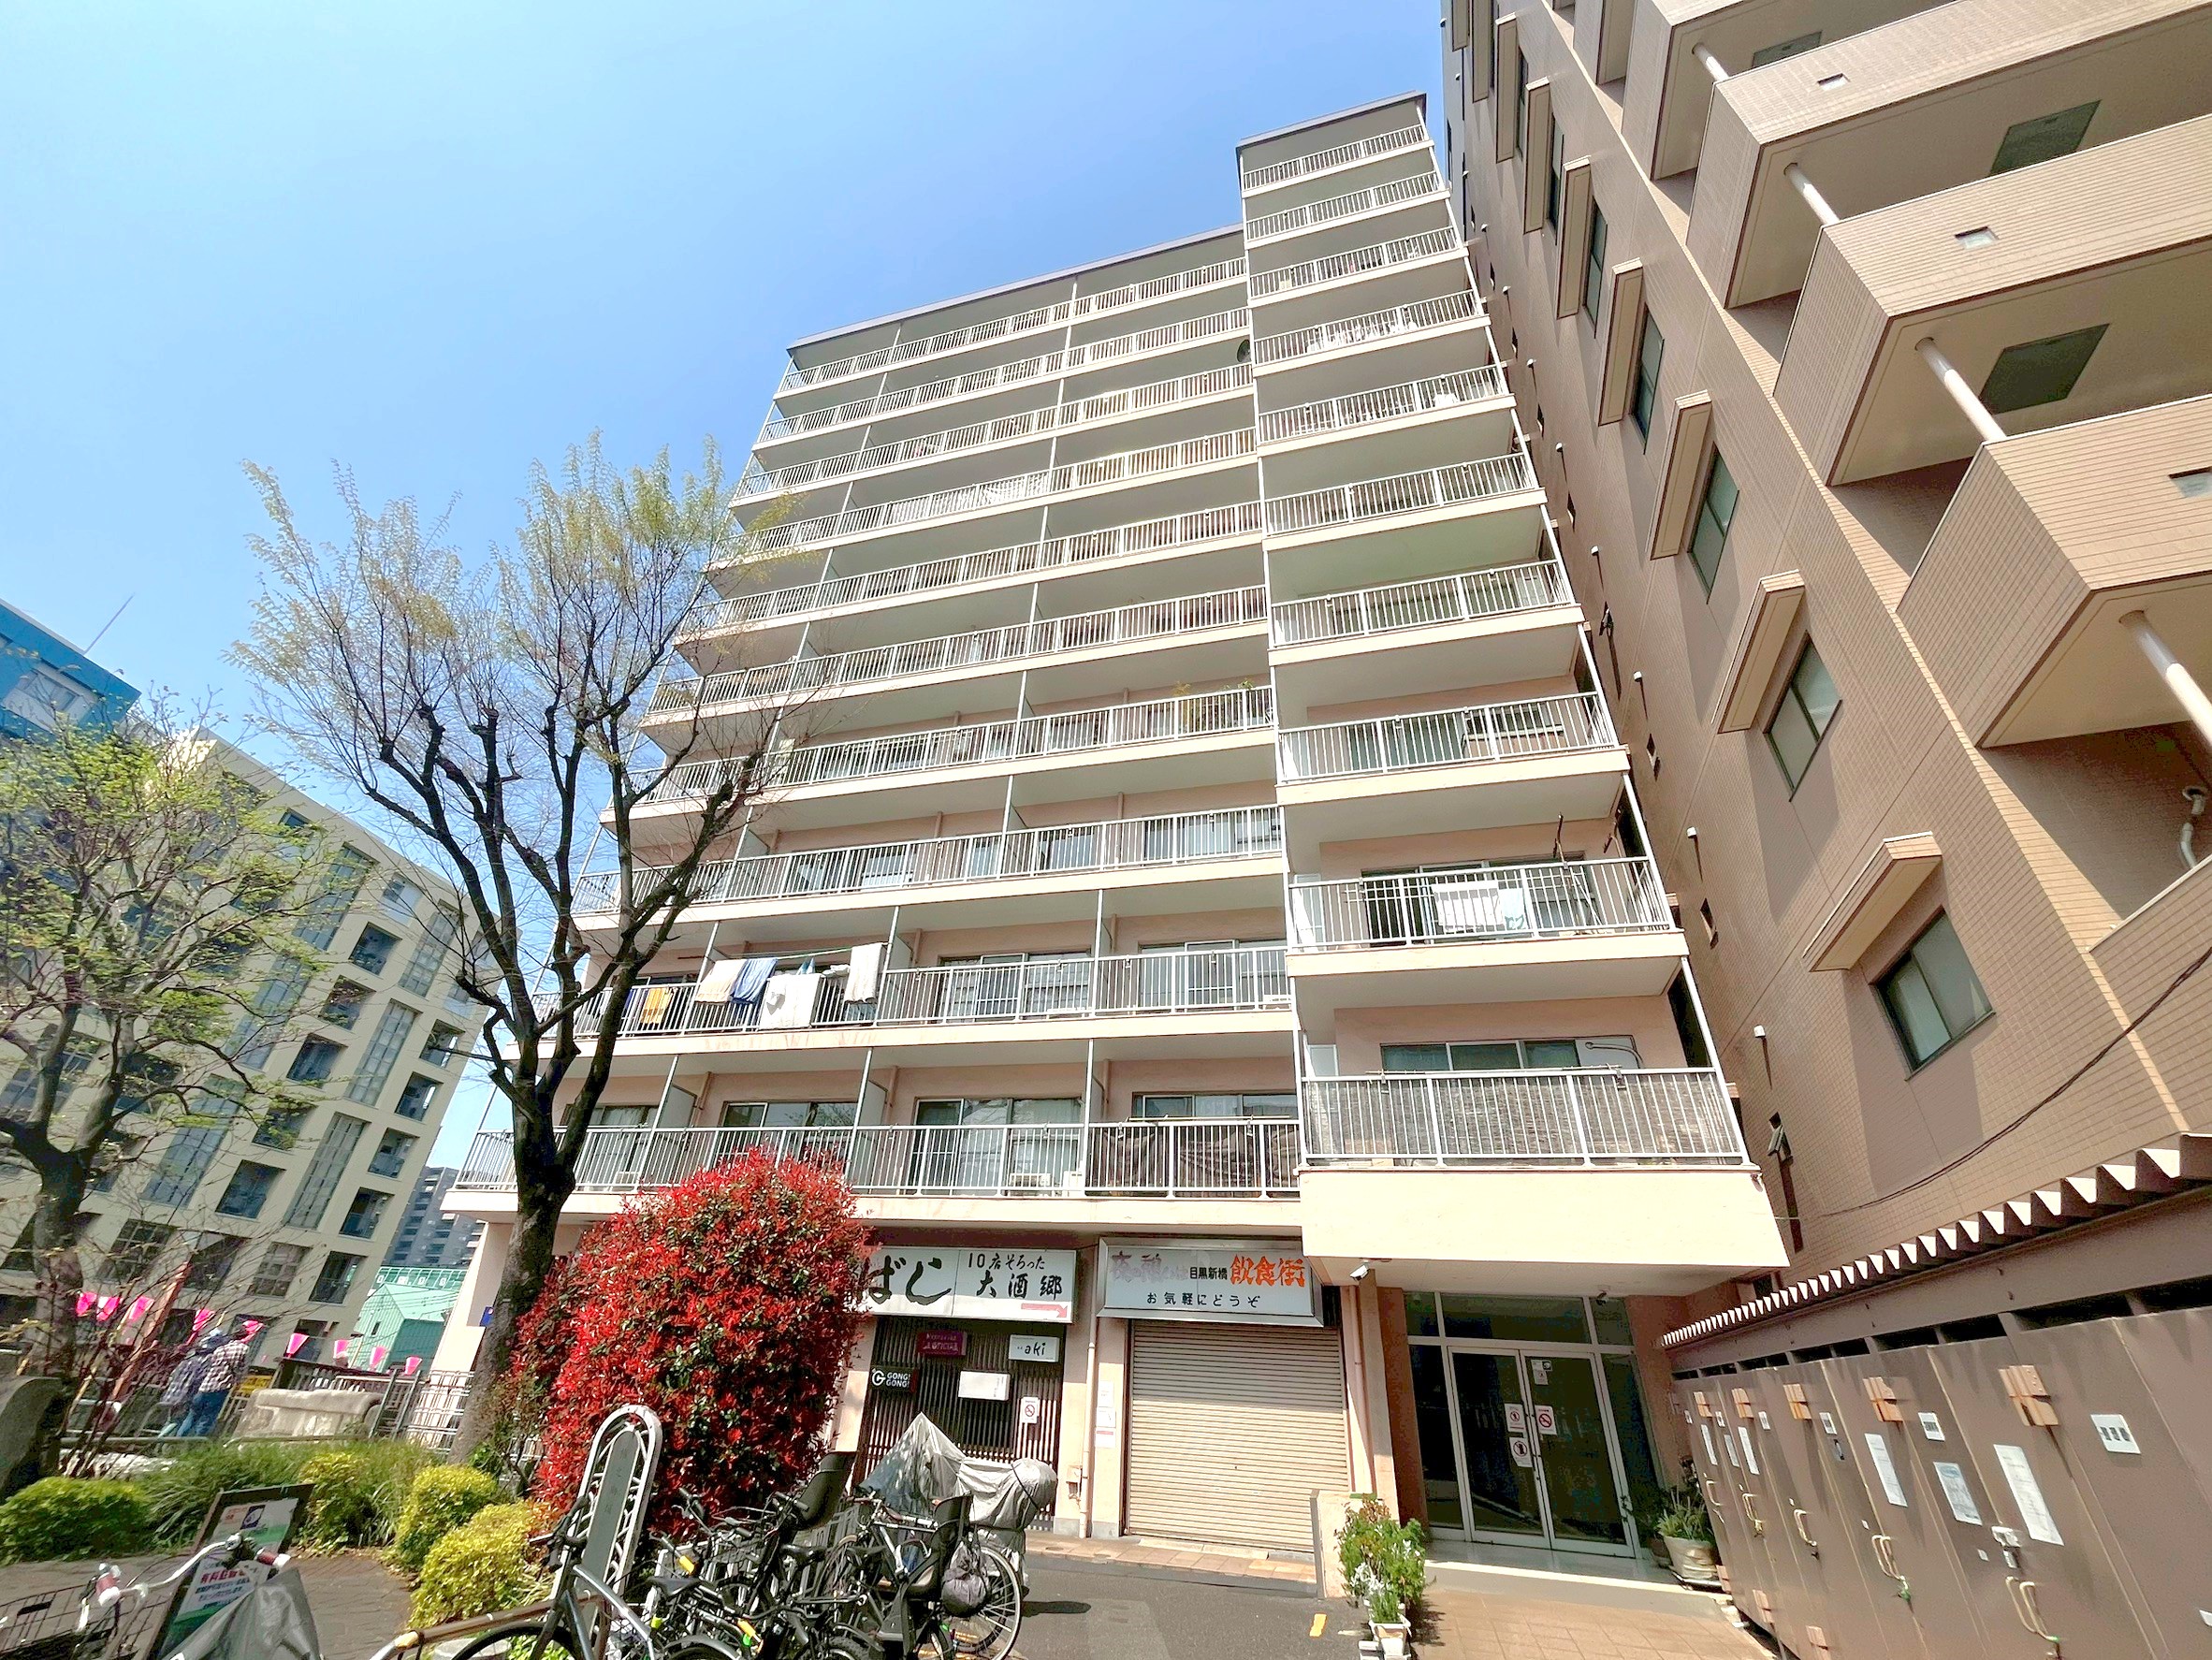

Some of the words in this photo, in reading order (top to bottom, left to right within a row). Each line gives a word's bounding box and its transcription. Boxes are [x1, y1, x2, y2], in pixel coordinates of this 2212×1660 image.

[1189, 1266, 1228, 1281] 目黒新橋
[1230, 1253, 1306, 1288] 飲食街
[976, 1270, 1063, 1301] 大酒郷
[1146, 1292, 1261, 1309] お気軽にどうぞ
[1025, 1341, 1046, 1357] aki
[886, 1379, 910, 1388] GONG!
[887, 1372, 910, 1381] GONG!
